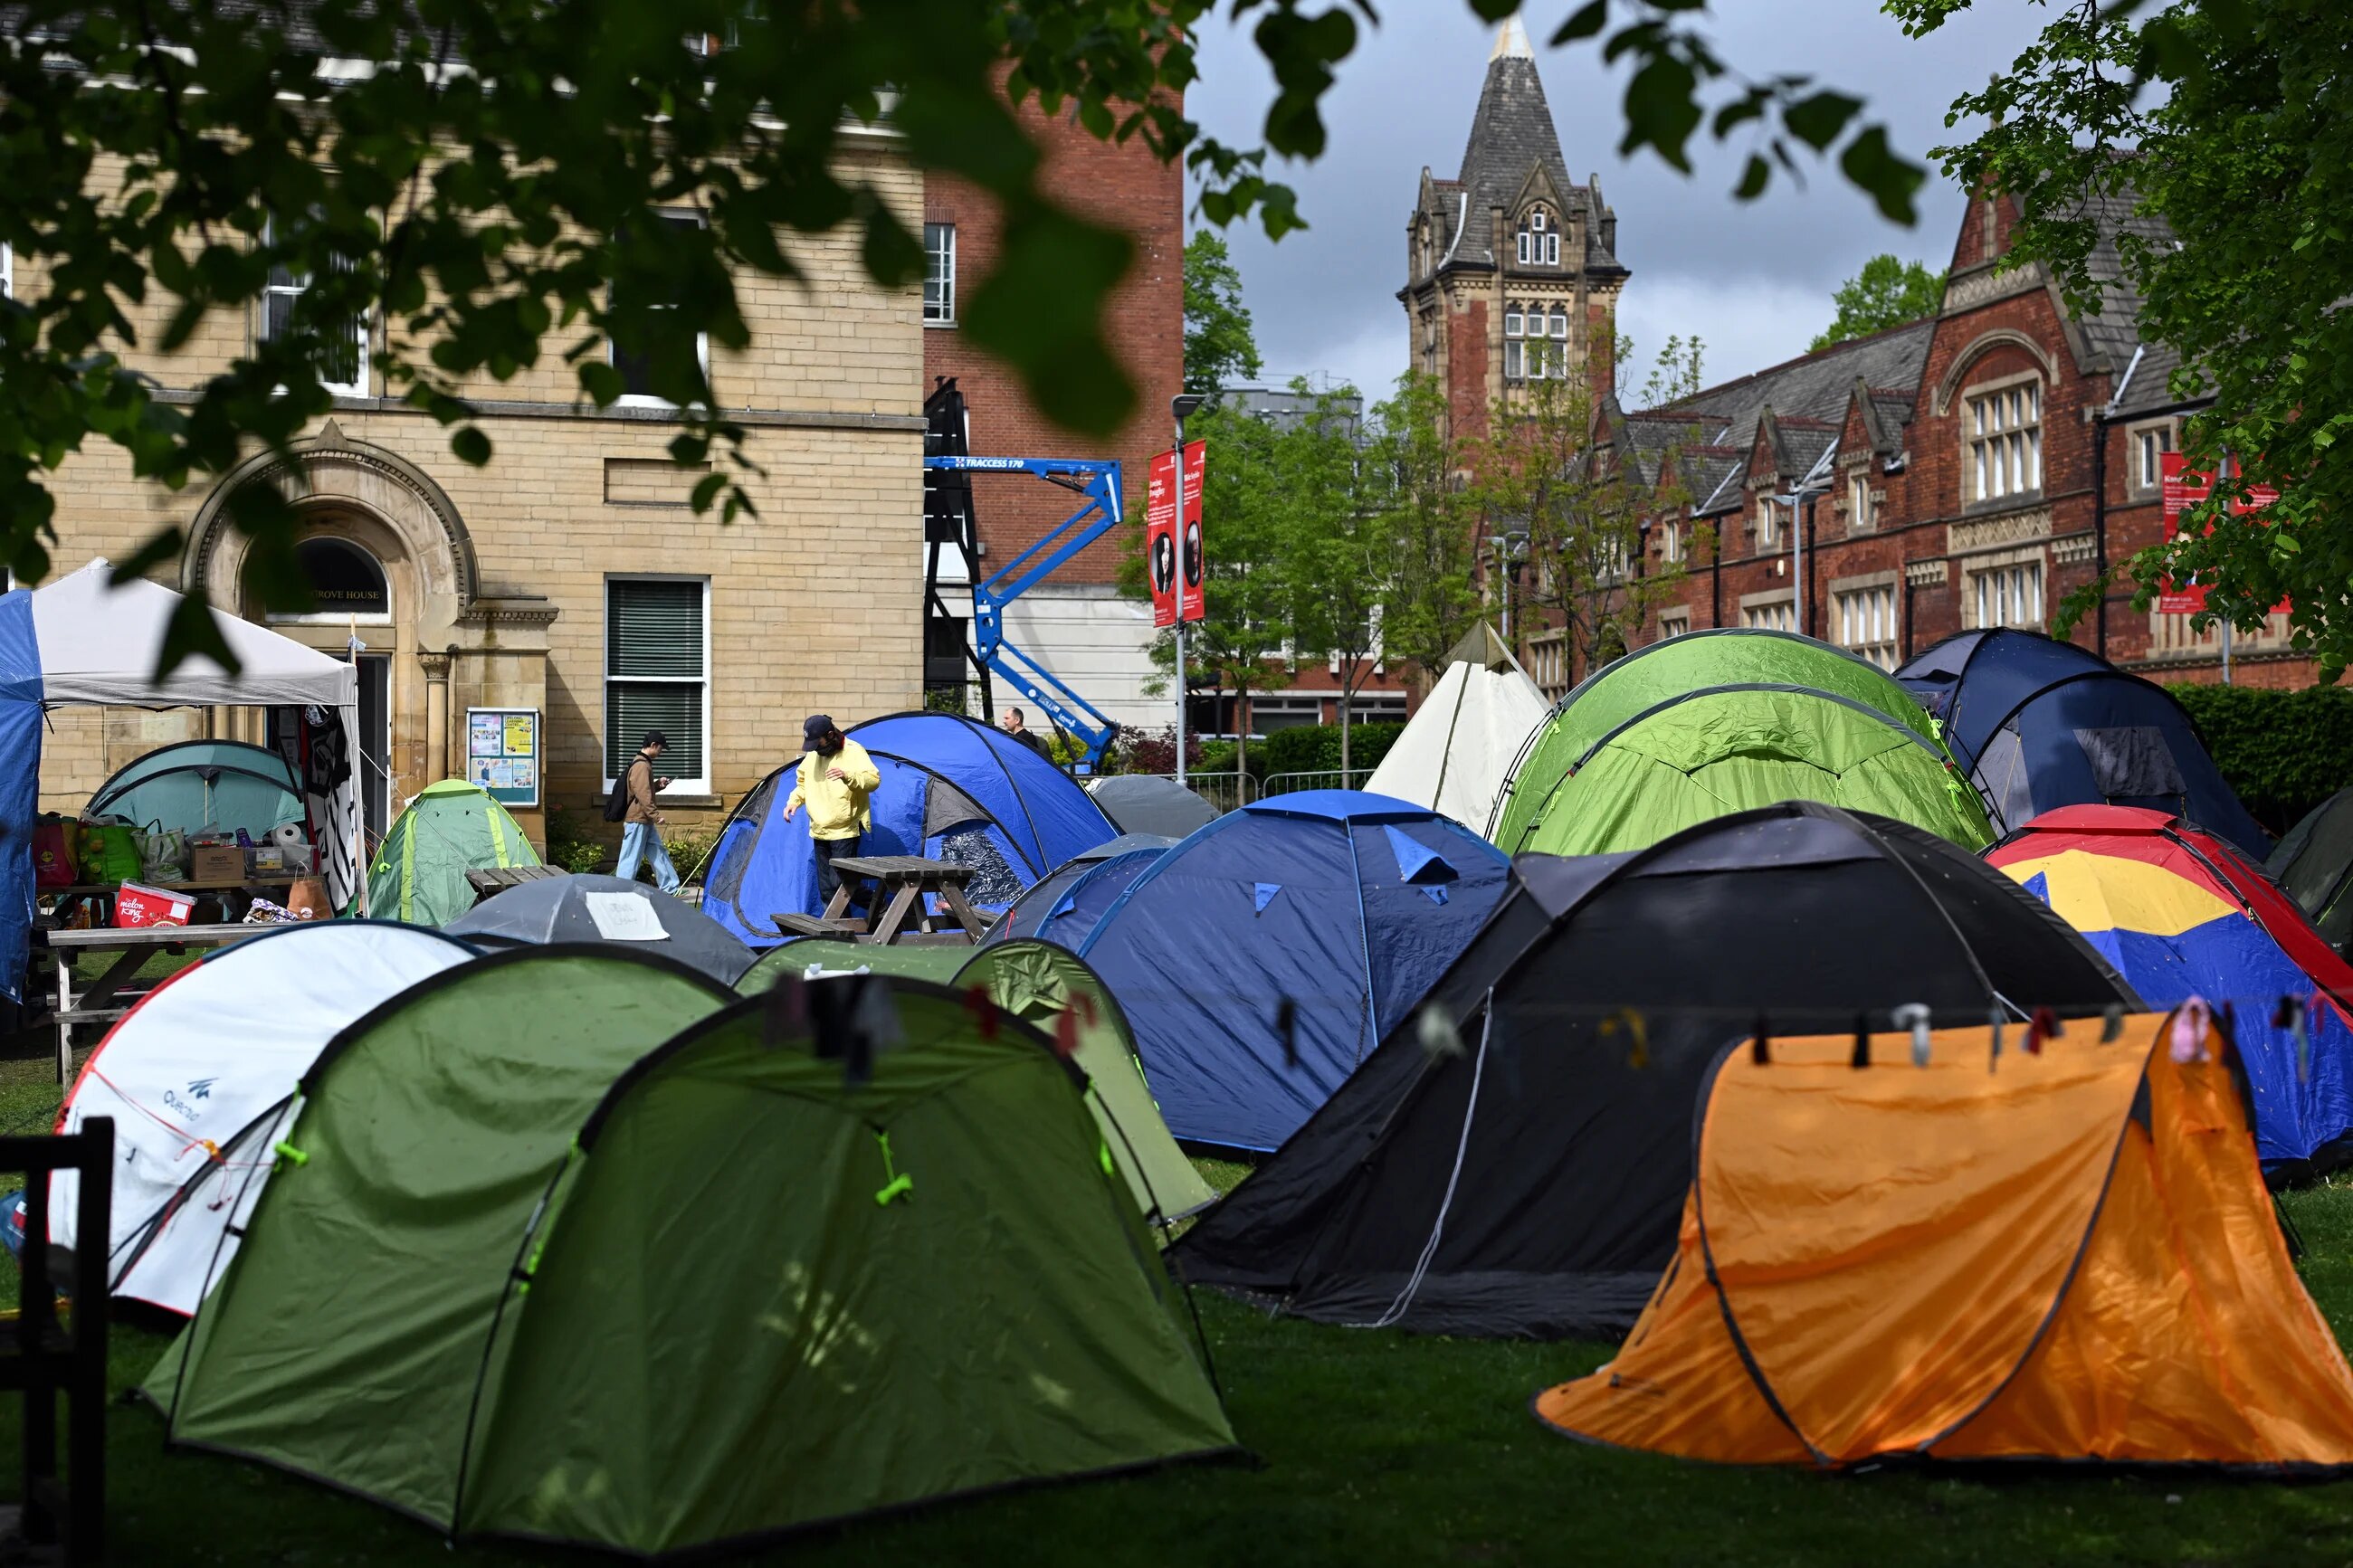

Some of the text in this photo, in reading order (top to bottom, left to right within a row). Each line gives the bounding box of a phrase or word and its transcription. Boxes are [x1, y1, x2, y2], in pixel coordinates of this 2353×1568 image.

[966, 459, 1024, 468] TRACCESS 170
[346, 590, 379, 599] HOUSE
[119, 898, 145, 909] melon
